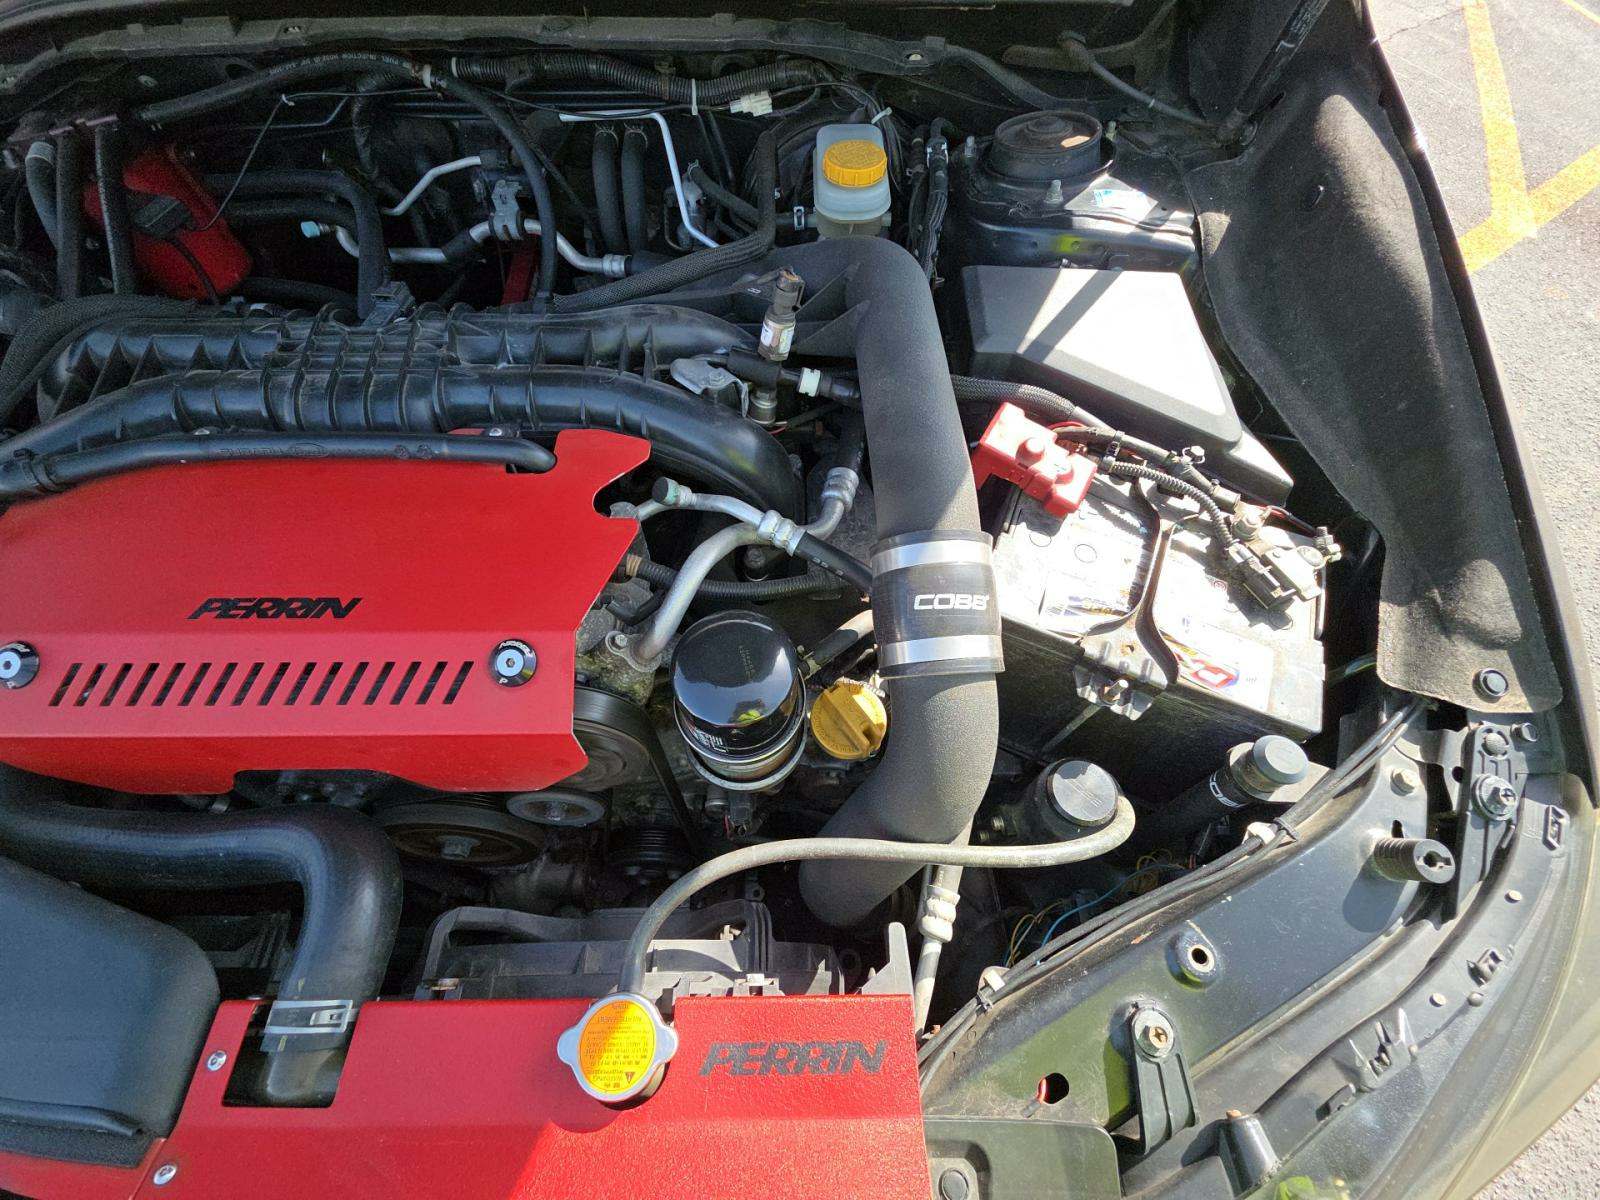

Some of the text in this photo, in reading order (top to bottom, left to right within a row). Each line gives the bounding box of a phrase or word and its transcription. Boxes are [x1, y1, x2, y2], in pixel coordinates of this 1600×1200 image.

[186, 597, 364, 619] PERRIN
[913, 593, 990, 611] COBB
[699, 1039, 887, 1076] PERRIN
